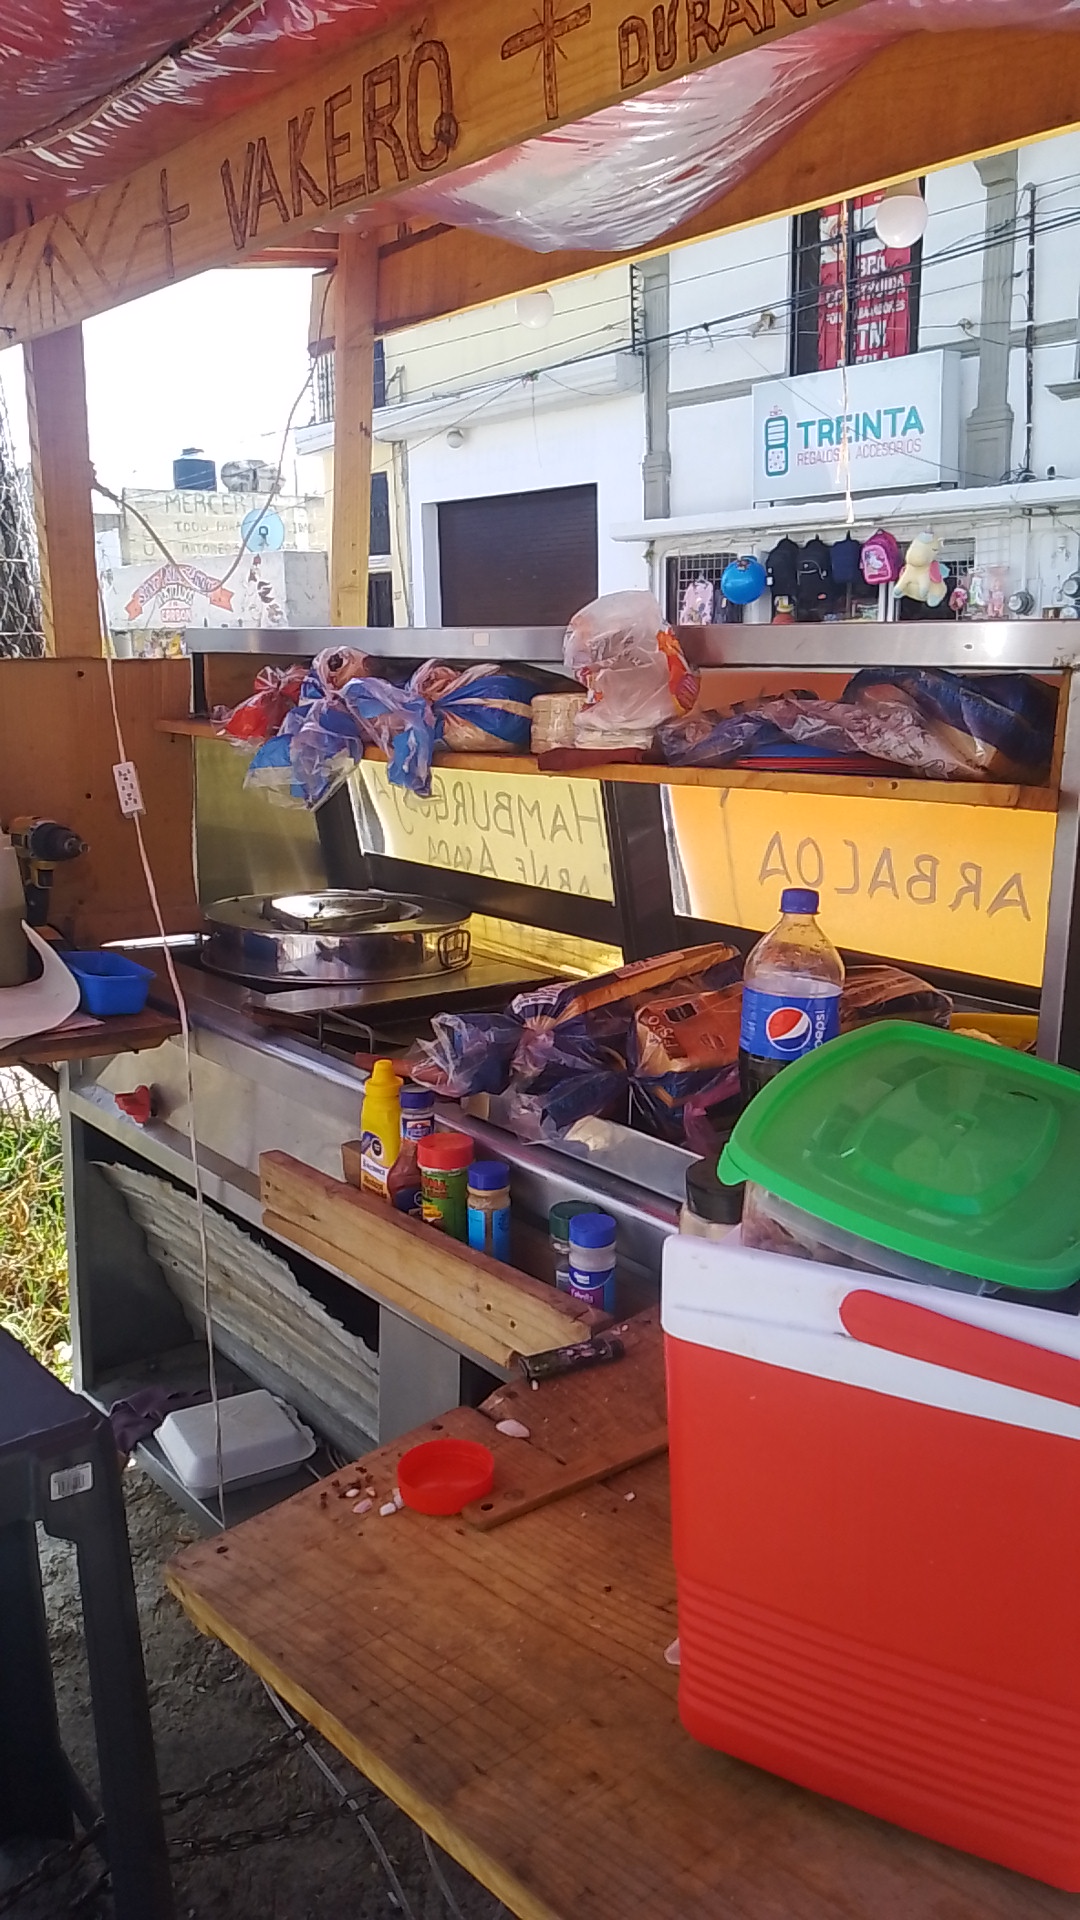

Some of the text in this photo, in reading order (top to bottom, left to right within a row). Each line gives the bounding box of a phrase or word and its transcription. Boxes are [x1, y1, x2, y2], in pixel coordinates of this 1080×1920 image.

[220, 0, 840, 250] VAKERO DURAN
[796, 405, 925, 450] TREINTA
[797, 447, 840, 467] REGALOS
[855, 438, 922, 460] ACCESORIOS
[165, 490, 277, 517] MERCERI
